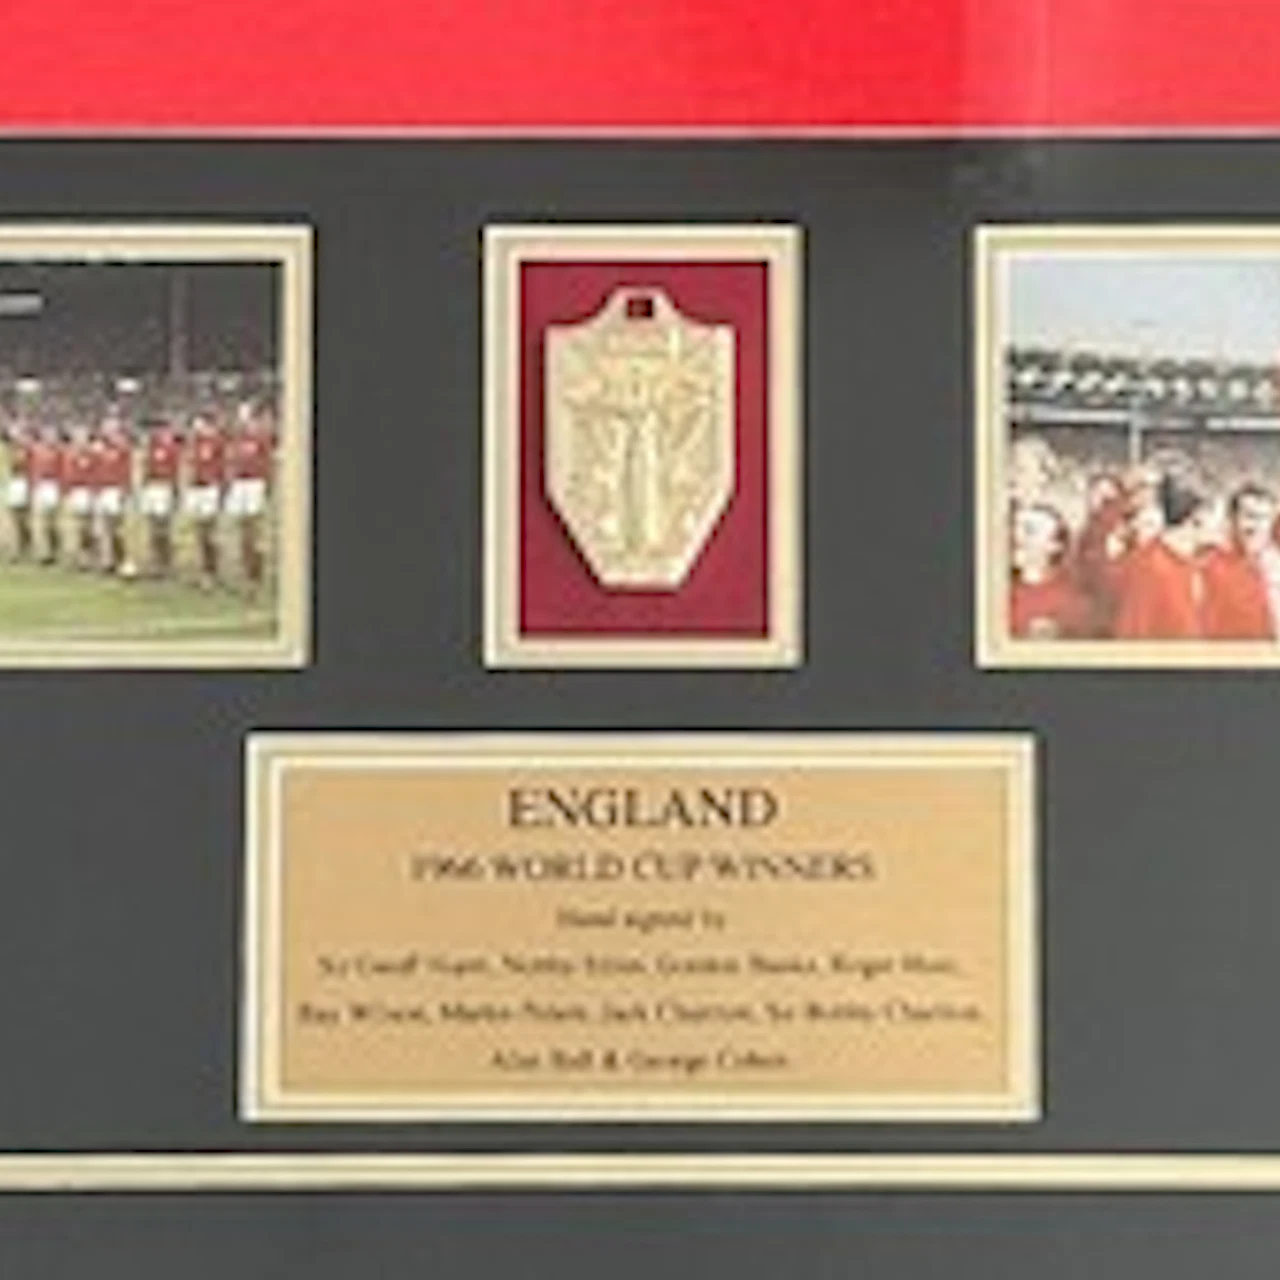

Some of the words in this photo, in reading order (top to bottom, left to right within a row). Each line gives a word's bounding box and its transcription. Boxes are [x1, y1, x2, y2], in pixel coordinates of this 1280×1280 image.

[507, 786, 779, 830] ENGLAND
[410, 851, 486, 882] 1966
[489, 851, 626, 882] WORLD
[630, 851, 703, 882] CUP
[707, 851, 876, 882] WINNERS
